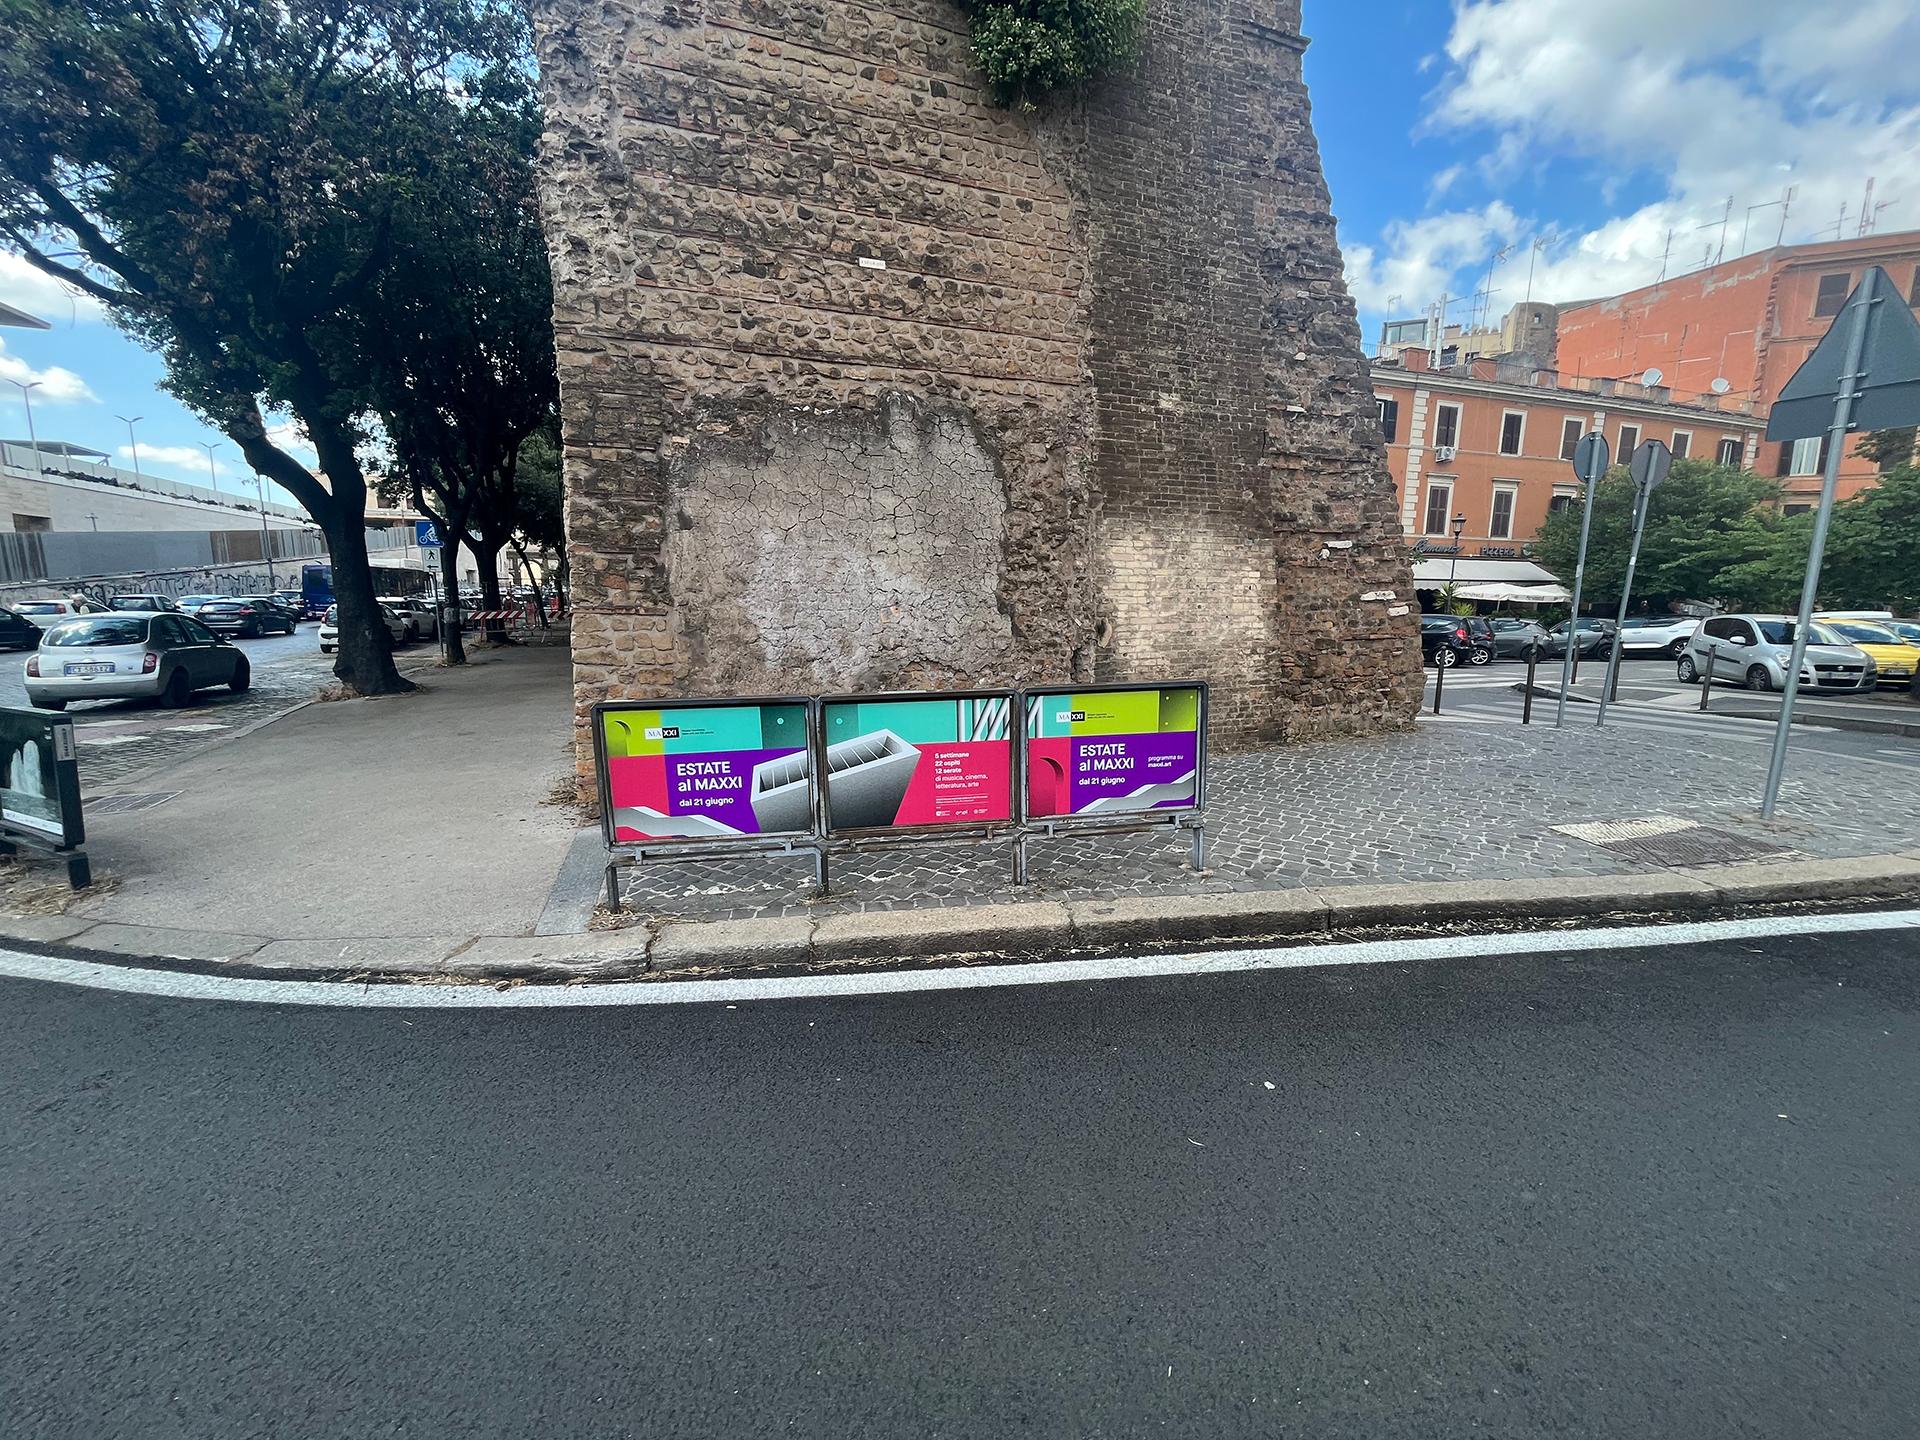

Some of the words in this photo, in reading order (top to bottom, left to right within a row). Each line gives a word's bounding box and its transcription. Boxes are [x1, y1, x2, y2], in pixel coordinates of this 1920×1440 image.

[1058, 712, 1084, 721] MAXXI
[646, 728, 678, 738] MAXXI
[1080, 744, 1125, 757] ESTATE
[1079, 759, 1090, 771] al
[1093, 757, 1134, 771] MAXXI
[1147, 755, 1176, 763] programma
[676, 761, 731, 776] ESTATE
[678, 779, 692, 792] al
[695, 776, 743, 791] MAXXI
[1079, 777, 1090, 785] dal
[1091, 777, 1099, 785] 21
[1101, 776, 1125, 786] giugno
[679, 798, 692, 807] dal
[694, 798, 703, 806] 21
[705, 797, 734, 808] giugno
